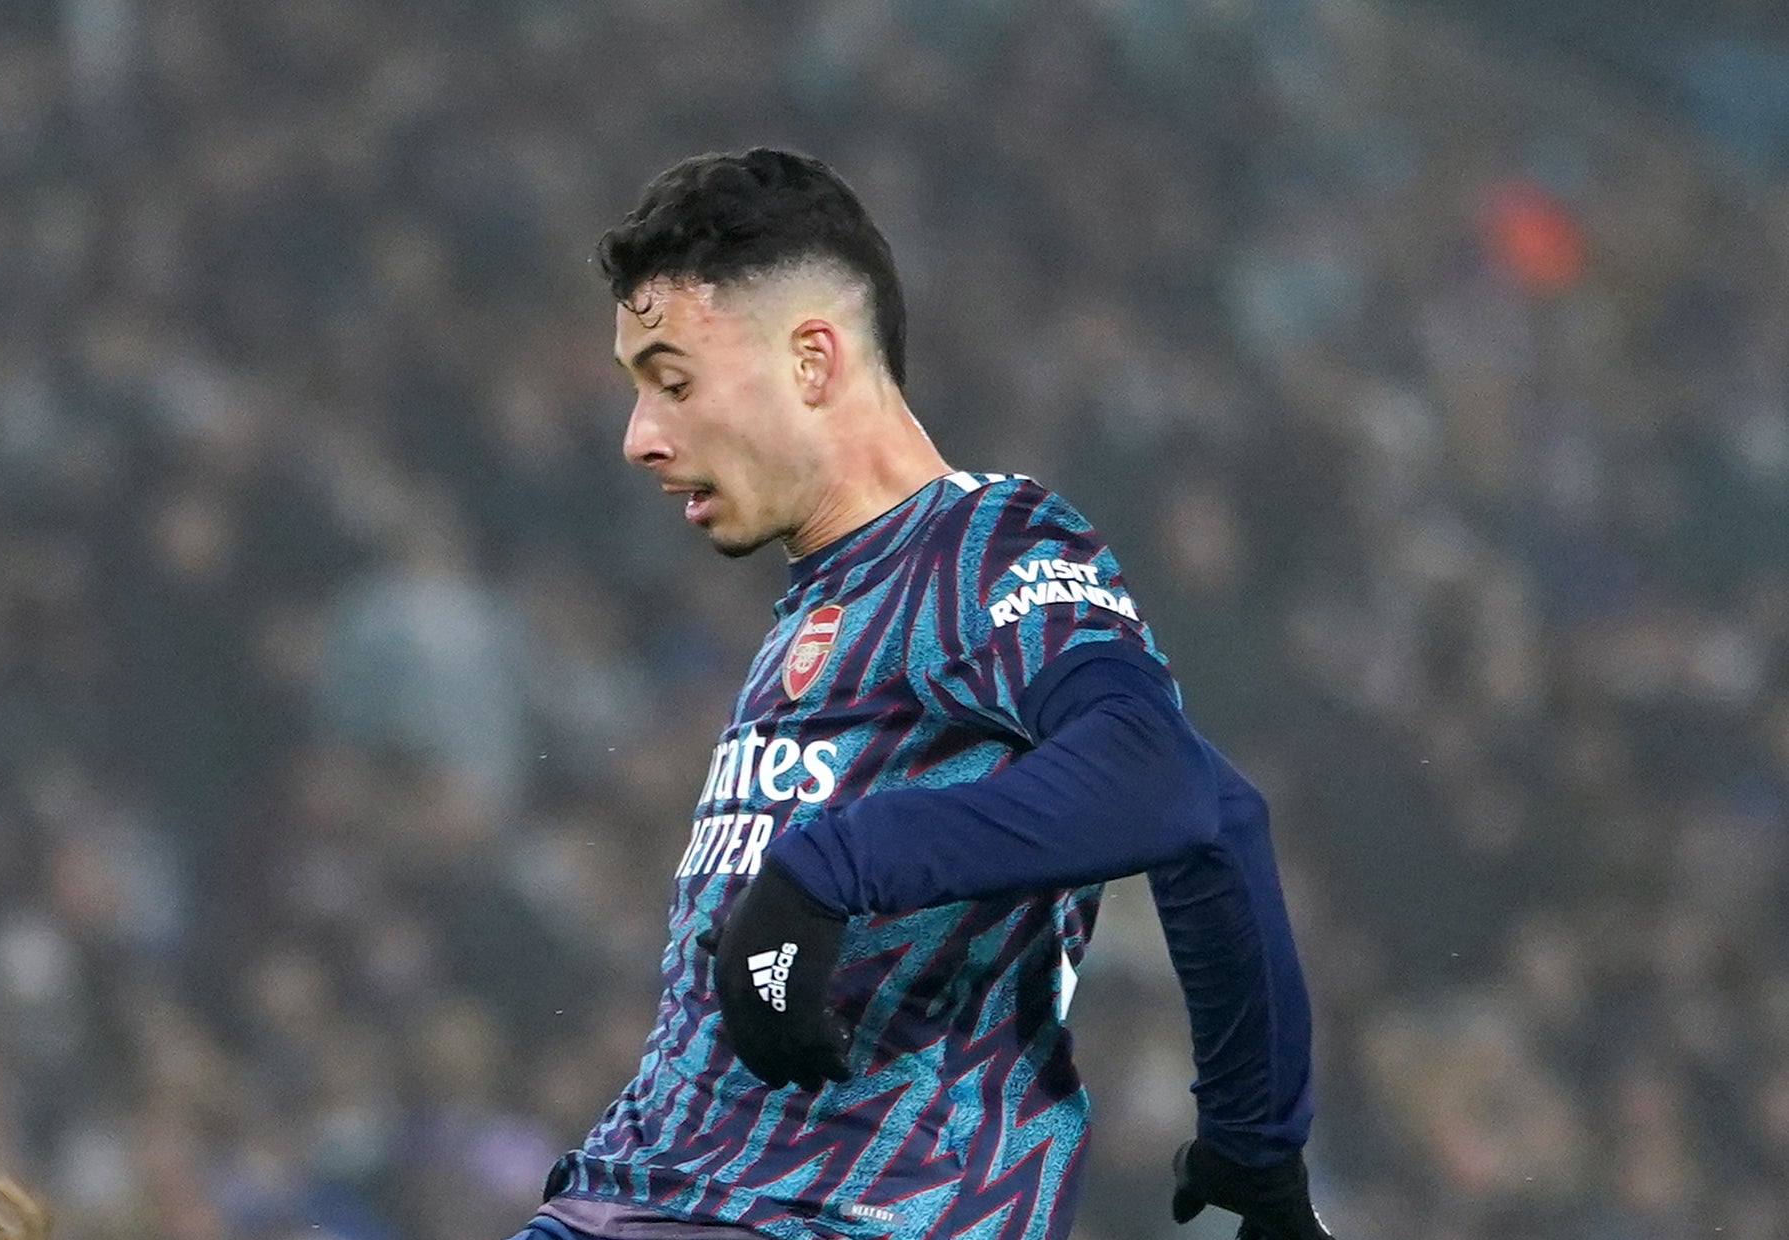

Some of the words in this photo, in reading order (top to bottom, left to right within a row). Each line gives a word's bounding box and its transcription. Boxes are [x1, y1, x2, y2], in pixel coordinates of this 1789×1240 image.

[1009, 559, 1099, 585] VISIT
[989, 580, 1140, 628] RWANDA
[696, 722, 839, 804] rates
[769, 942, 799, 1013] adidas
